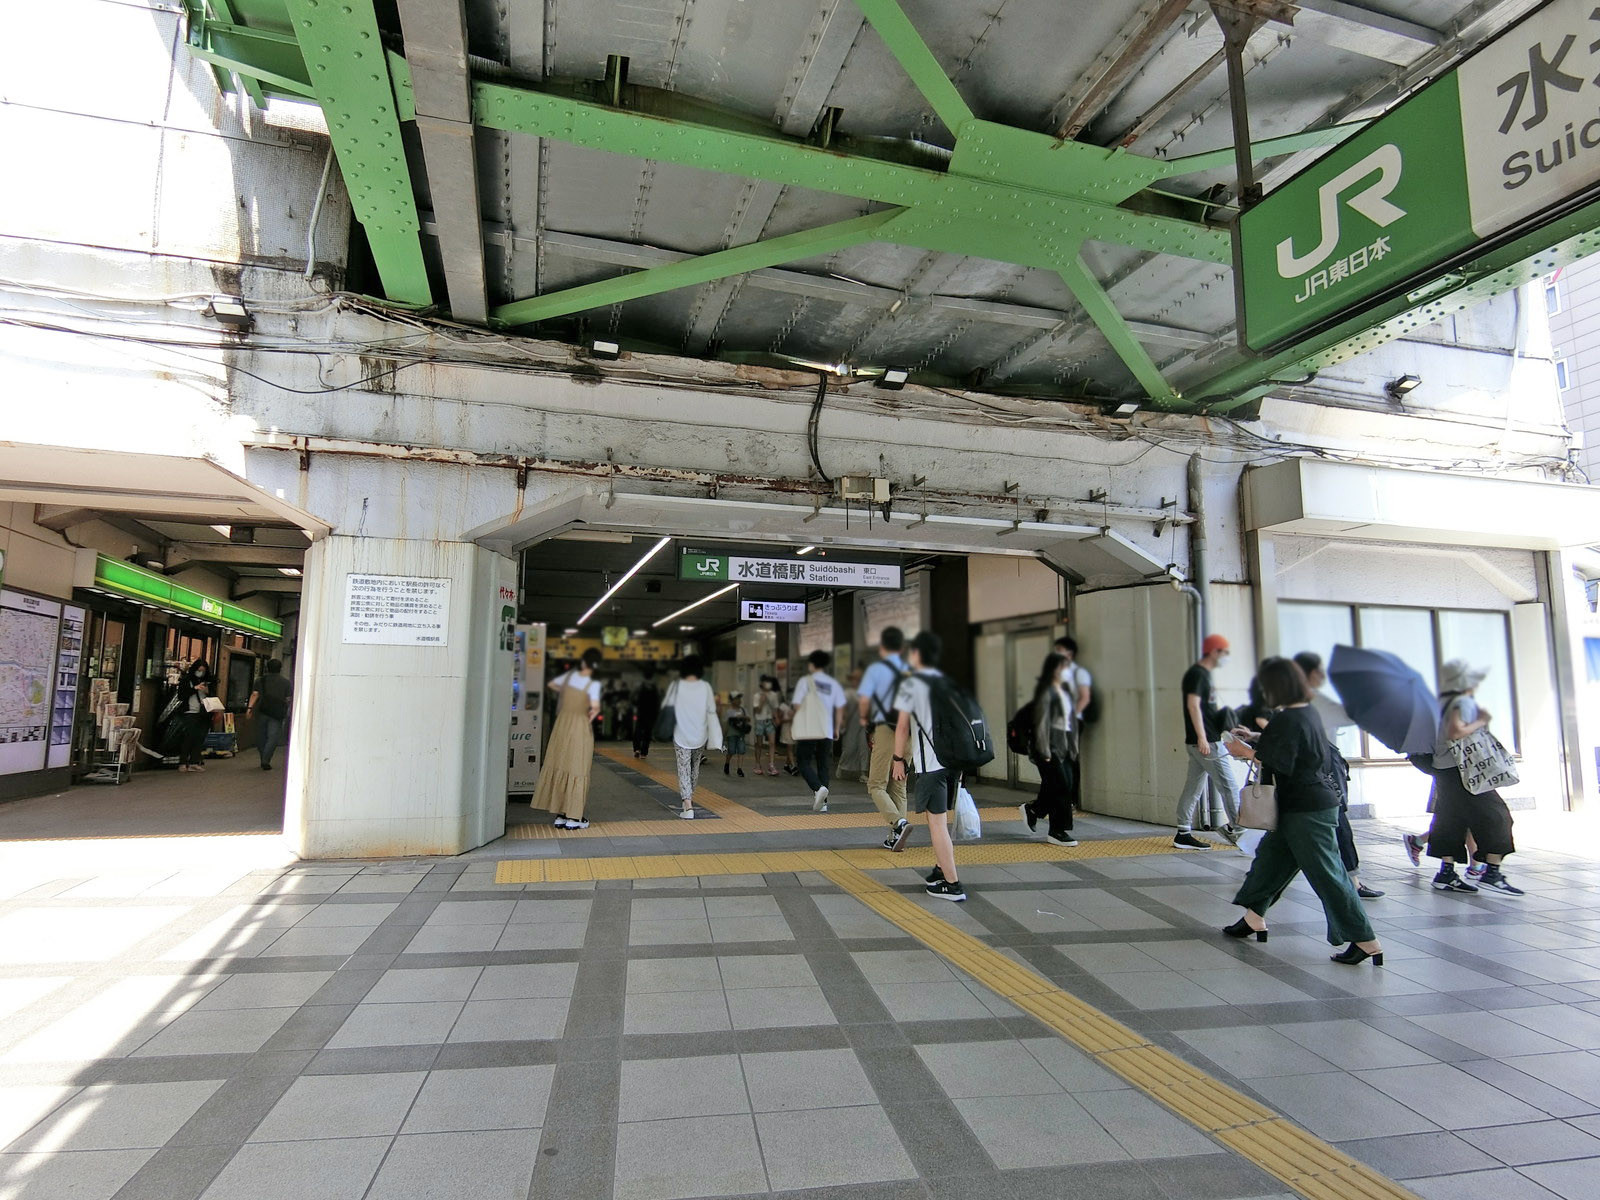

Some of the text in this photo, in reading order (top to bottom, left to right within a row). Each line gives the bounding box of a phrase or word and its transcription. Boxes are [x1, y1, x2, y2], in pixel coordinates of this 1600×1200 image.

[1276, 143, 1408, 278] JR
[1294, 235, 1392, 304] JR東日本
[696, 558, 720, 572] JR
[738, 561, 805, 580] 水道橋駅
[809, 564, 856, 574] Suidōbashi
[863, 567, 877, 575] 東口
[809, 573, 839, 582] Station
[351, 585, 438, 595] 次の行為を行うことを禁じます。
[1463, 741, 1483, 757] 1971
[1474, 756, 1497, 772] 1971
[1487, 771, 1511, 786] 1971
